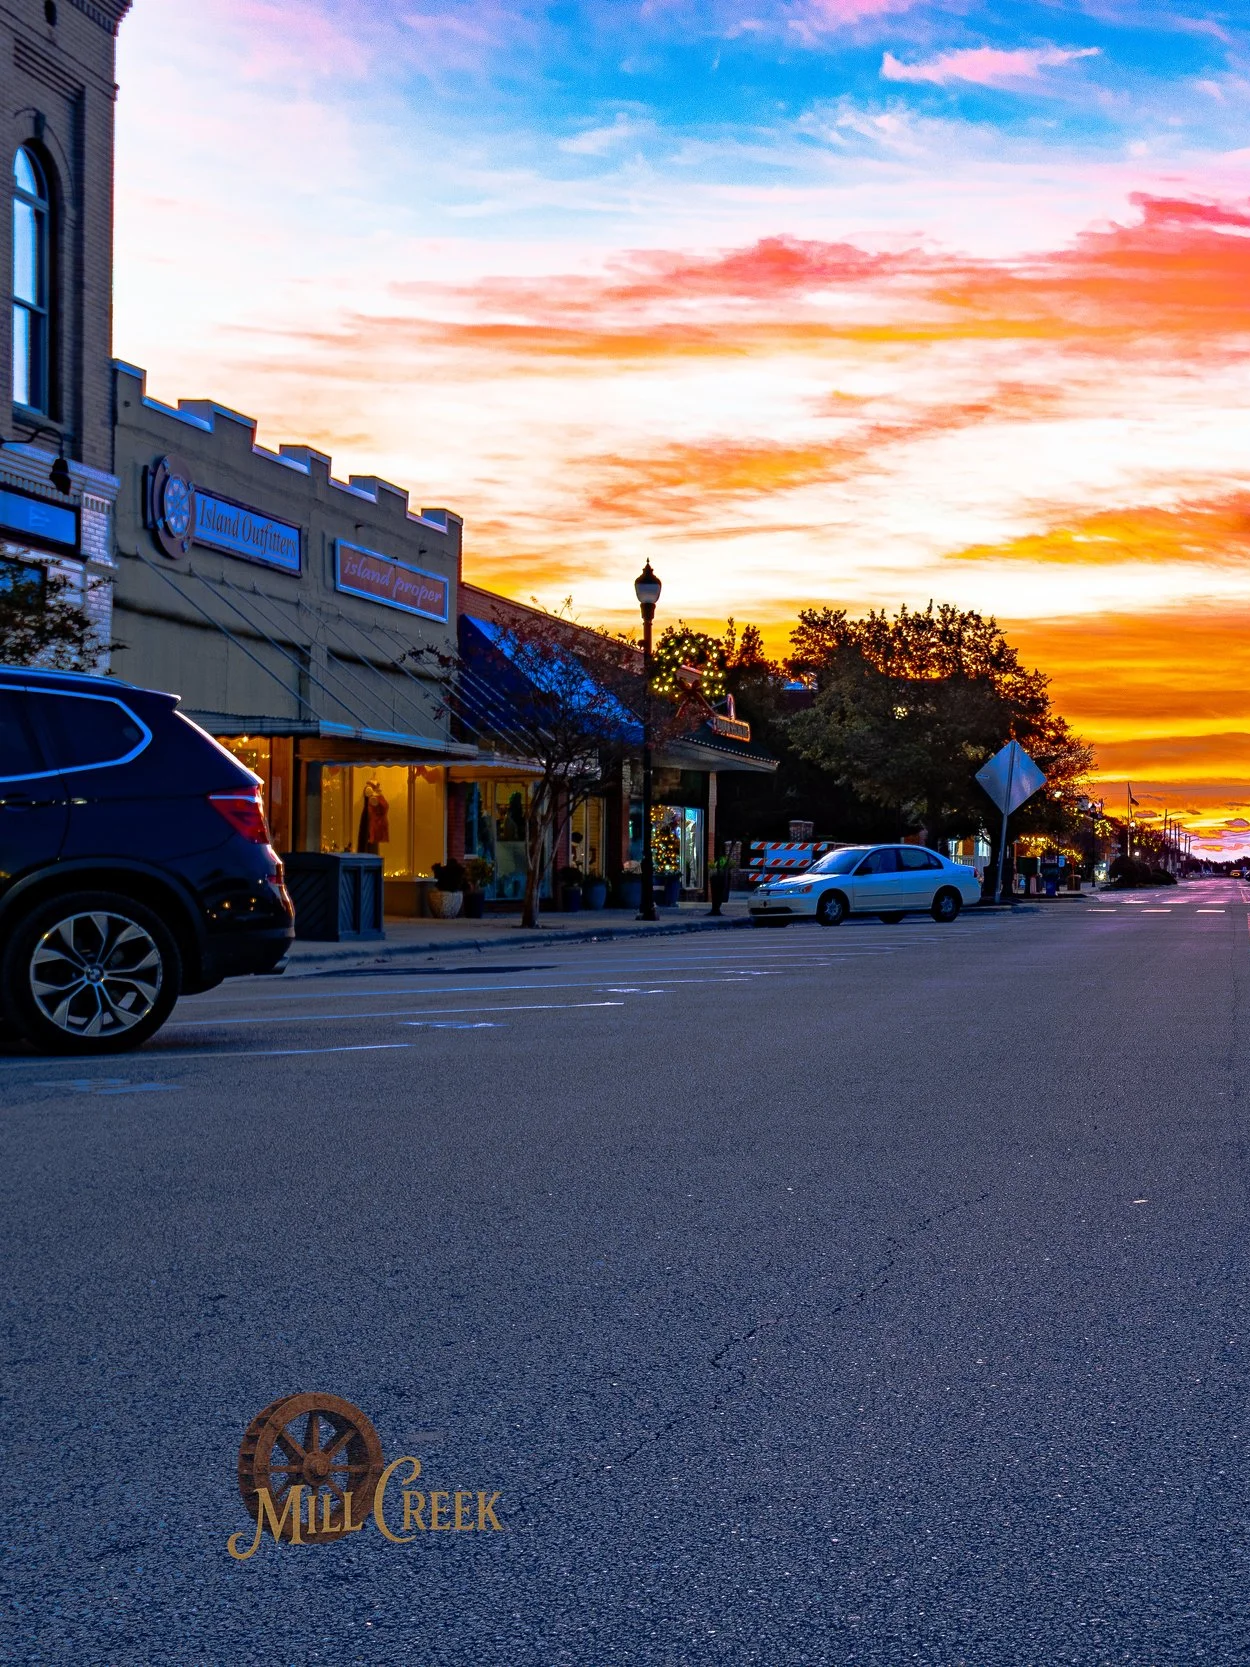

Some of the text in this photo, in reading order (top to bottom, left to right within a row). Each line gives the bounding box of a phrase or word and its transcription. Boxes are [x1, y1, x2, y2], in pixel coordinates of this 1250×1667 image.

[200, 499, 297, 557] Island Outfitters
[344, 556, 442, 607] island proper
